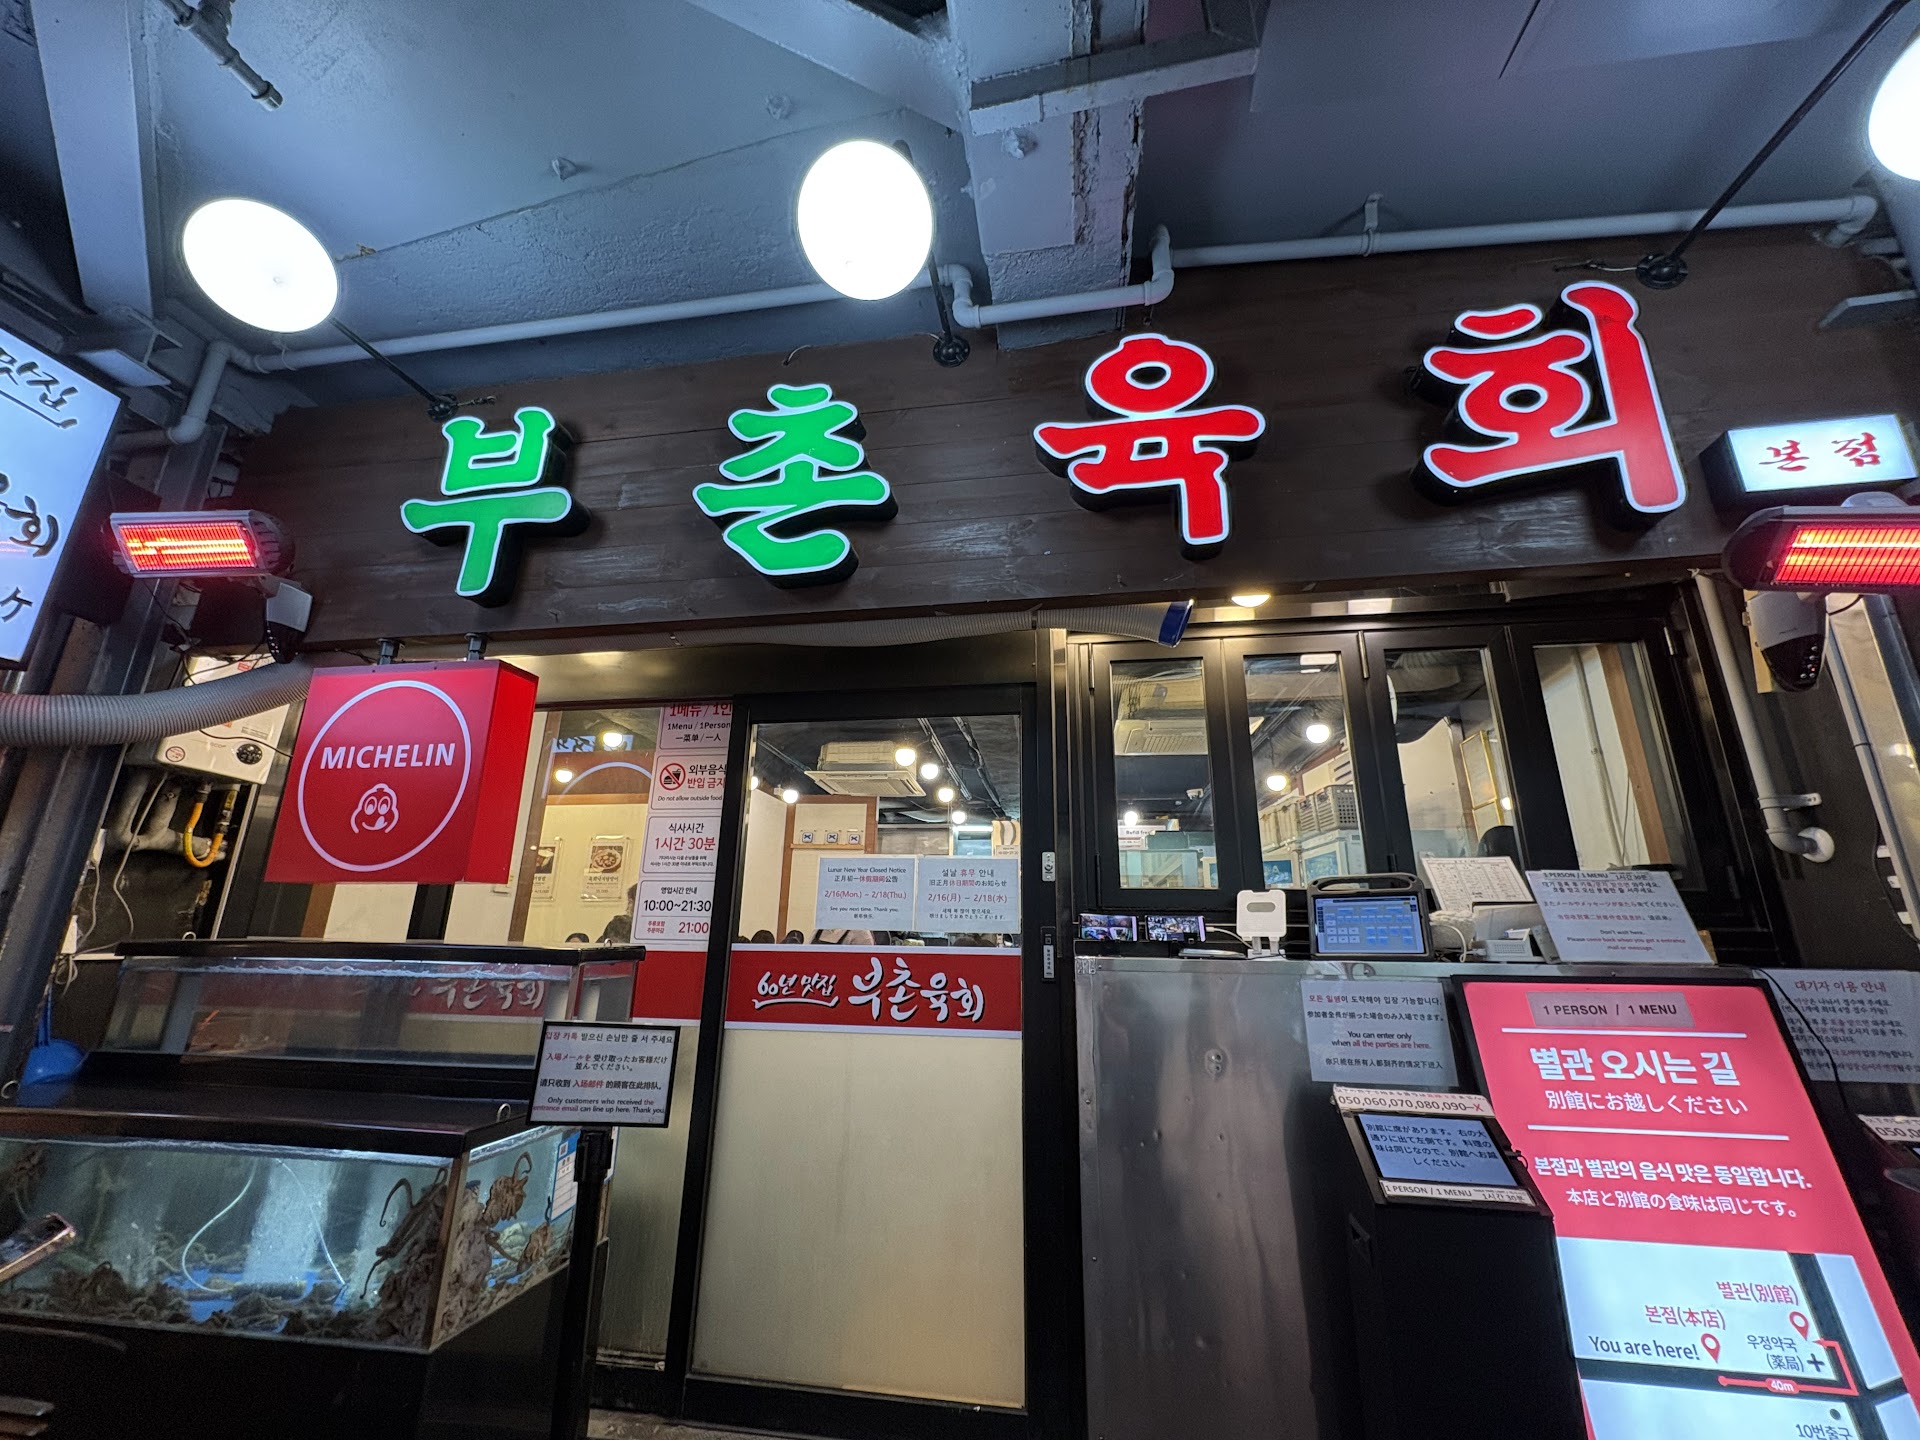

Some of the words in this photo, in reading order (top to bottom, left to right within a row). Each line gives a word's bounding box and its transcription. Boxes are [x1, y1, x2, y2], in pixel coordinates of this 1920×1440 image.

[668, 722, 693, 731] 1Menu
[699, 721, 731, 730] 1Person
[320, 743, 456, 770] MICHELIN
[687, 777, 706, 789] 반입
[668, 822, 704, 834] 식사시간
[655, 836, 686, 851] 1시간
[687, 836, 716, 851] 30분
[942, 868, 957, 877] 설날
[960, 868, 975, 877] 휴무
[978, 868, 994, 878] 안내
[660, 886, 685, 895] 영업시간
[685, 886, 698, 895] 안내
[824, 890, 862, 899] 2/16(Mon.)
[871, 891, 907, 899] 2/18(Thu.)
[643, 899, 712, 912] 10:00~21:30
[678, 921, 709, 934] 21:00
[757, 971, 797, 997] 60년
[800, 972, 838, 998] 맛집
[848, 956, 985, 1022] 부촌육회
[1833, 981, 1858, 993] 이용
[1861, 981, 1887, 993] 안내
[1543, 1005, 1550, 1015] 1
[1553, 1005, 1608, 1015] PERSON
[1628, 1005, 1635, 1015] 1
[1639, 1004, 1678, 1015] MENU
[640, 1034, 649, 1044] 서
[1347, 1030, 1361, 1039] You
[1396, 1032, 1413, 1041] only
[1331, 1039, 1351, 1047] when
[1352, 1039, 1360, 1047] all
[1361, 1040, 1374, 1048] the
[1375, 1040, 1399, 1049] parties
[1529, 1047, 1596, 1082] 별관
[1600, 1049, 1698, 1085] 오시는
[1701, 1051, 1741, 1087] 길
[547, 1096, 564, 1105] Only
[616, 1098, 643, 1106] received
[1545, 1089, 1748, 1116] 別館にお越しください
[592, 1105, 604, 1113] line
[605, 1106, 614, 1114] up
[632, 1106, 651, 1114] Thank
[1875, 1127, 1920, 1139] 050,0
[1412, 1157, 1466, 1168] しください。
[1534, 1156, 1584, 1178] 본점과
[1584, 1159, 1637, 1181] 별관의
[1639, 1161, 1676, 1182] 음식
[1676, 1163, 1713, 1185] 맛은
[1714, 1165, 1813, 1190] 동일합니다.
[1392, 1185, 1428, 1194] PERSON
[1444, 1188, 1472, 1197] MENU
[1566, 1187, 1798, 1218] 本店と別館の食味は同じです。
[1716, 1281, 1799, 1306] 별관(別館)
[1644, 1305, 1726, 1331] 본점(本店)
[1588, 1335, 1623, 1354] You
[1624, 1342, 1652, 1357] are
[1652, 1339, 1700, 1361] here!
[1746, 1334, 1798, 1354] 우정약국
[1770, 1380, 1795, 1393] 40m
